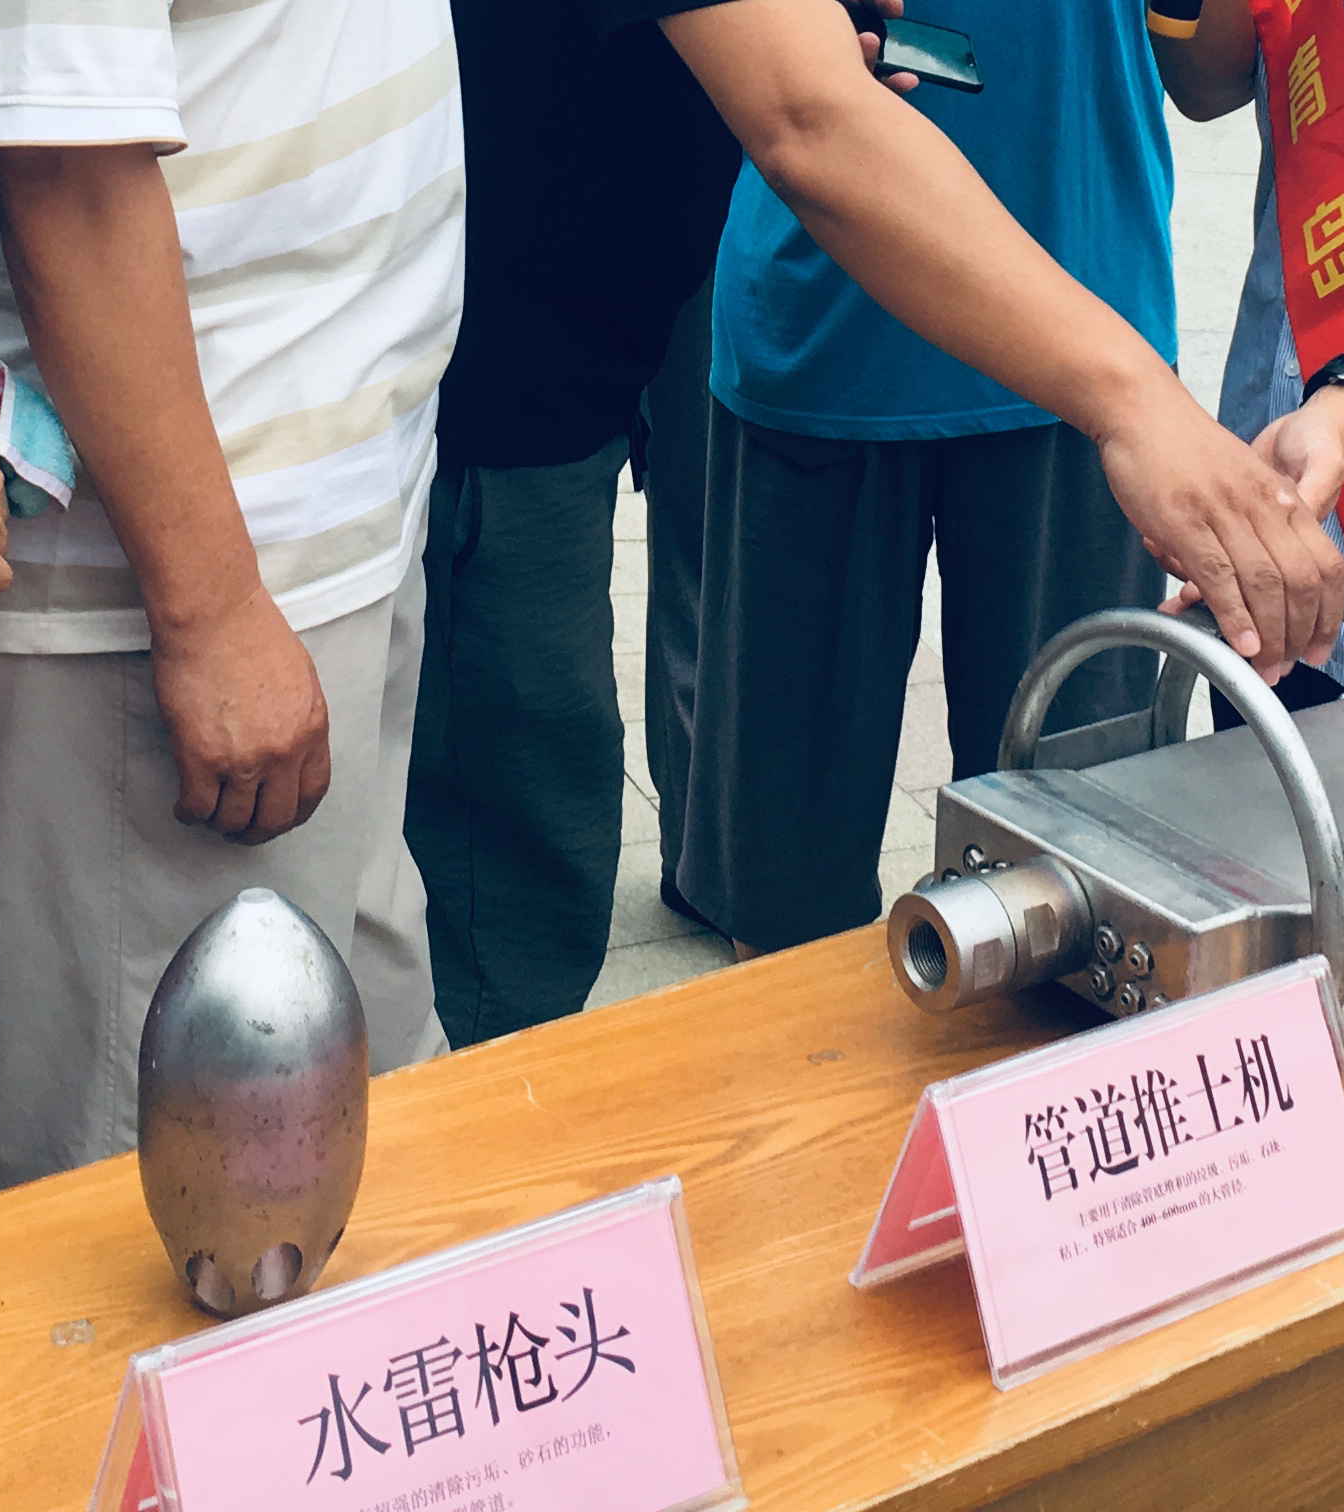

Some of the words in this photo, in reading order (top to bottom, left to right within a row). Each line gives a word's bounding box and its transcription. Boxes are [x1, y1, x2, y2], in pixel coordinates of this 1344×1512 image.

[1024, 1033, 1296, 1202] 管道推土机
[297, 1287, 638, 1487] 水雷枪头
